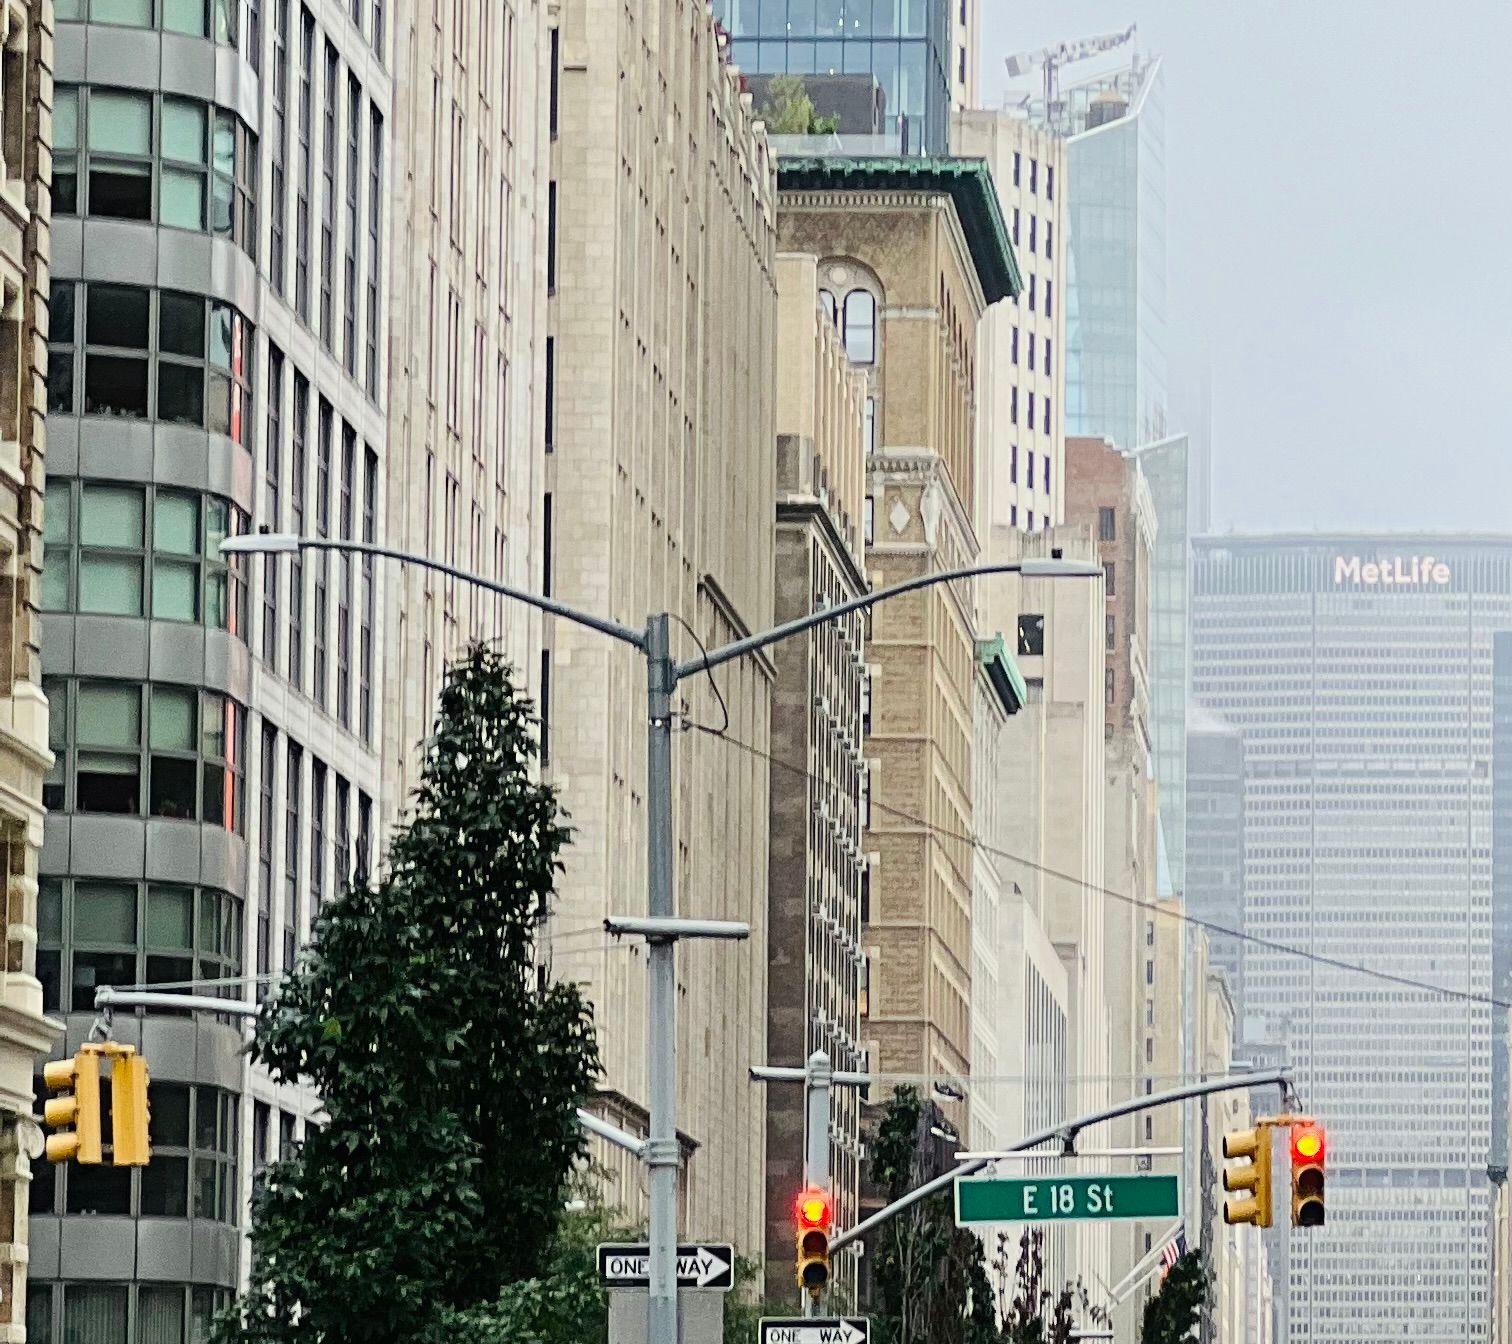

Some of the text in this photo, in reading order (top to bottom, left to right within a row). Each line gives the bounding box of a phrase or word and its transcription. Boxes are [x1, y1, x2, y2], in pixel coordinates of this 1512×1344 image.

[1334, 556, 1450, 584] MetLife
[1023, 1183, 1114, 1215] E 18 St
[610, 1258, 713, 1276] ONE WAY
[770, 1328, 853, 1344] ONE WAY
